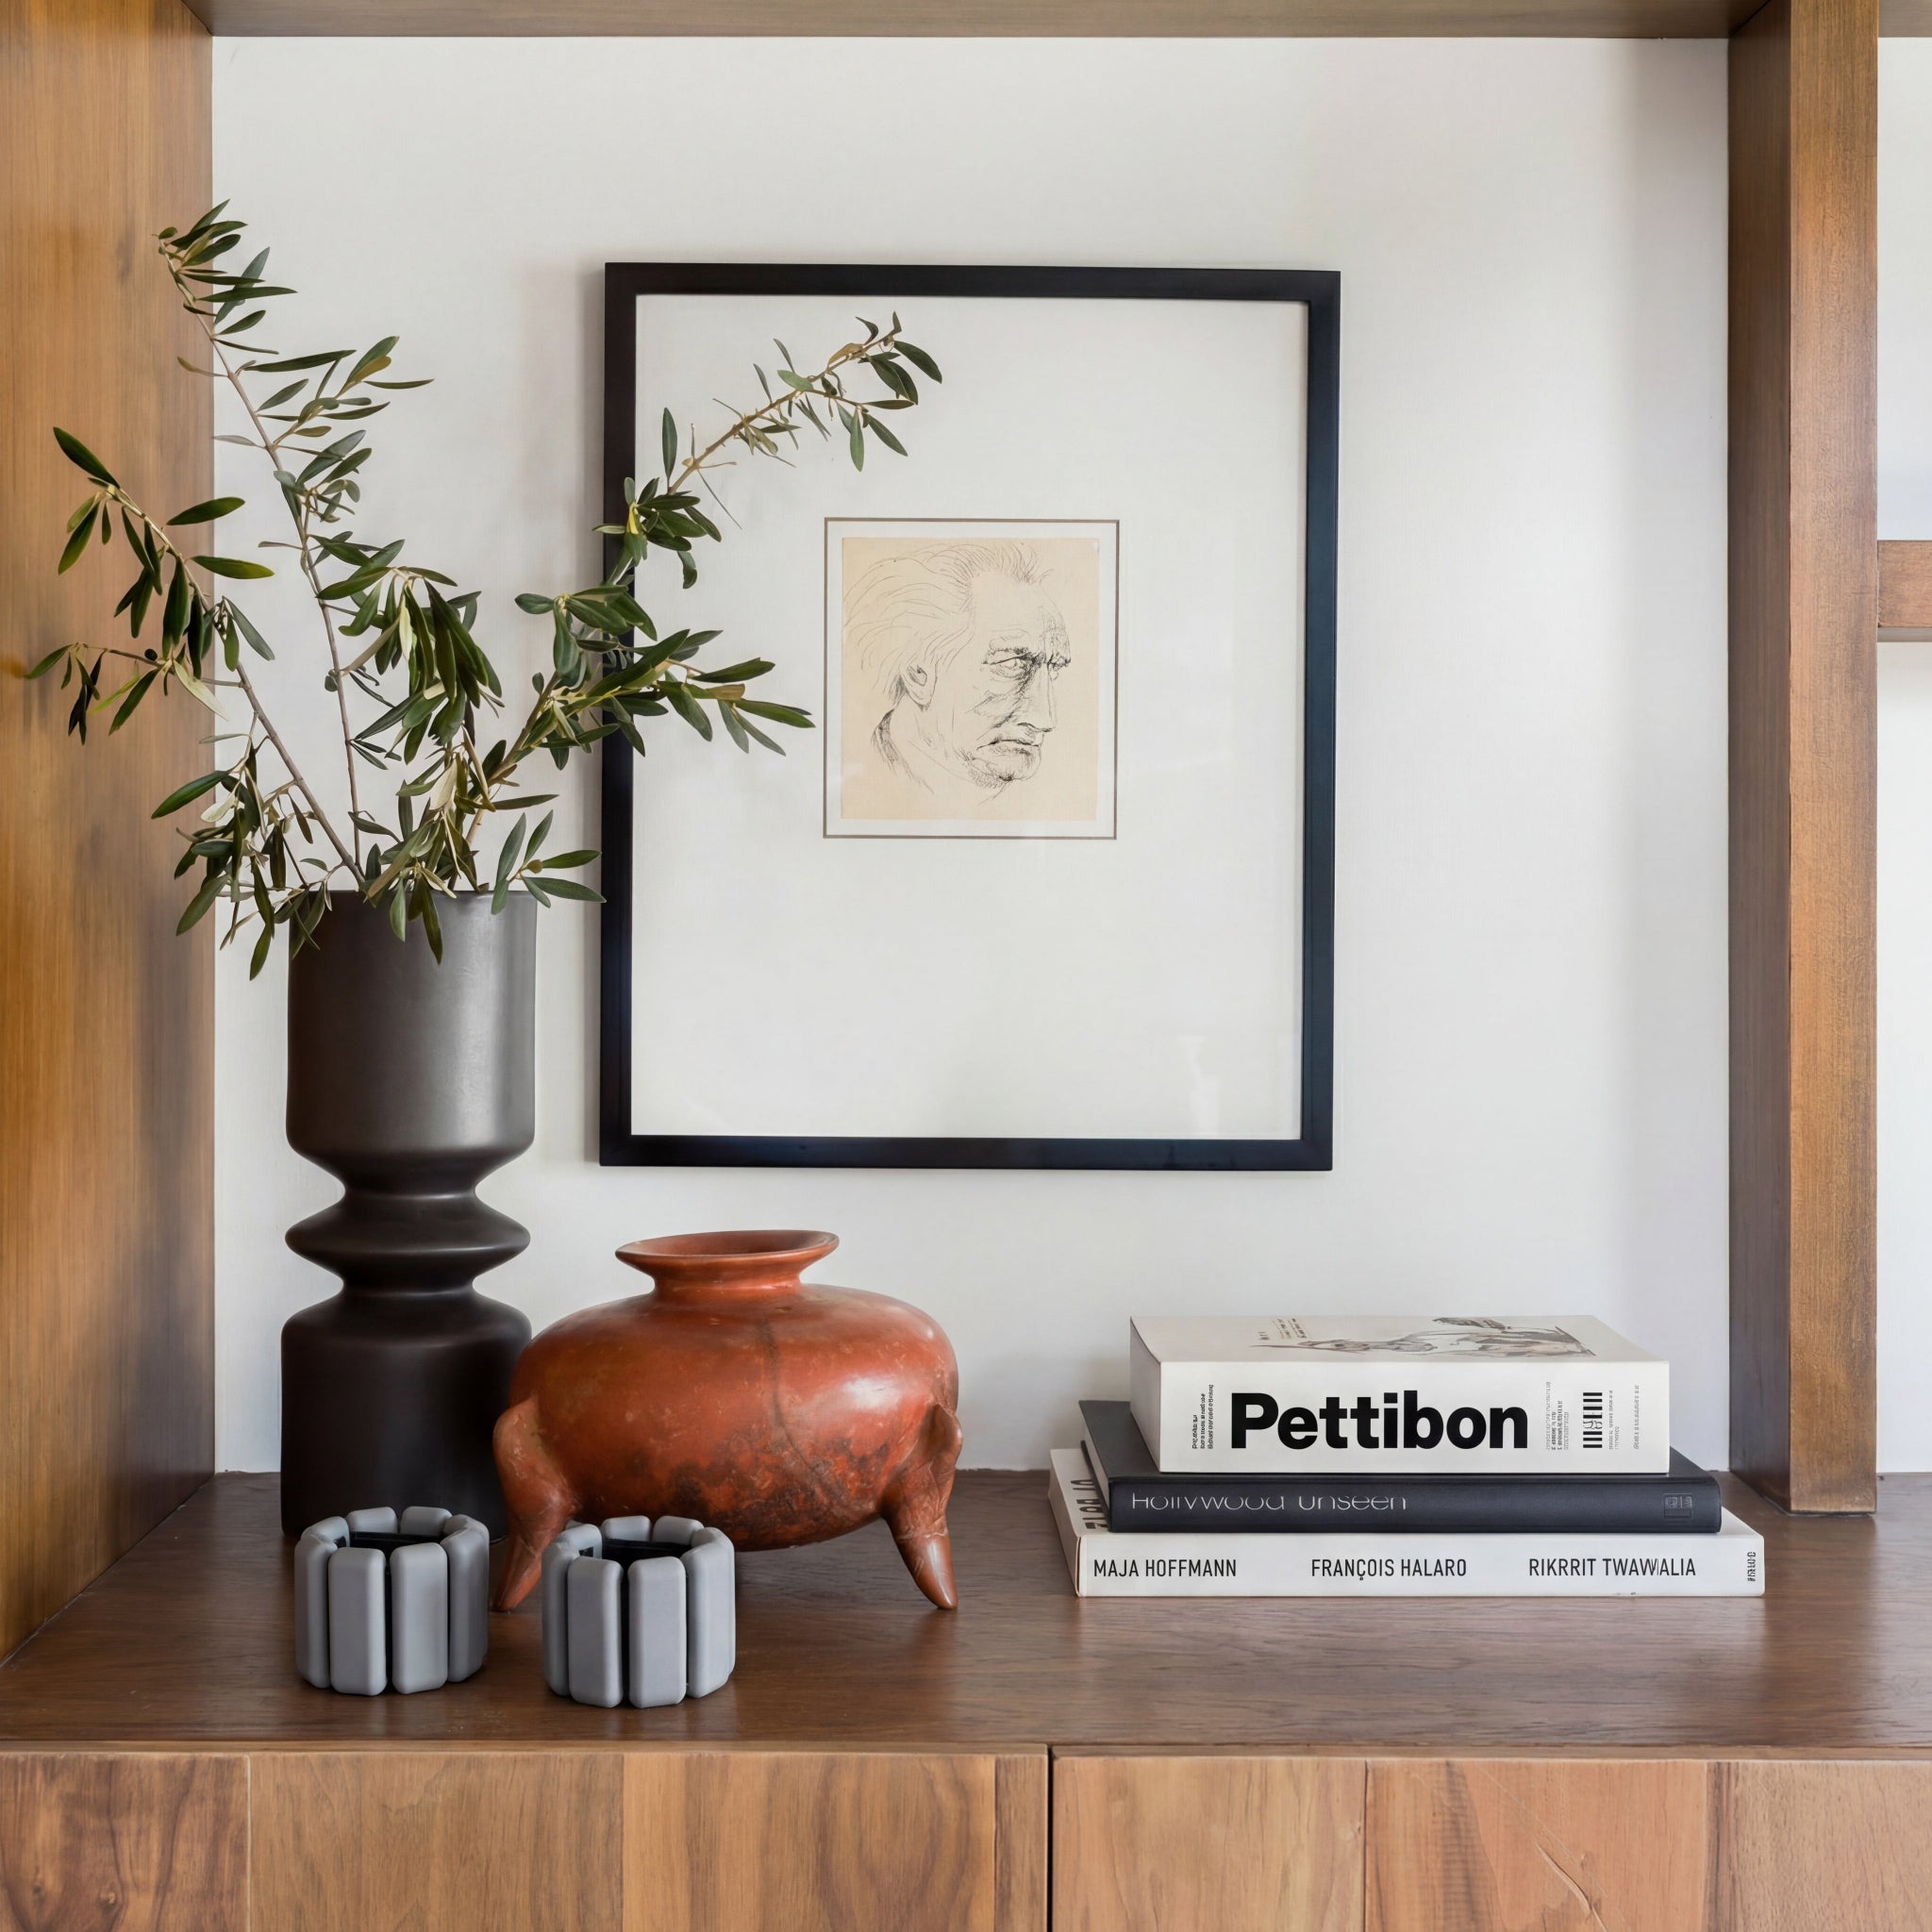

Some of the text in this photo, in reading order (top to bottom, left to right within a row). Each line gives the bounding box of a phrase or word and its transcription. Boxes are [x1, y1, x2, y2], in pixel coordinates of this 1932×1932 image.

[1231, 1390, 1528, 1450] Pettibon
[1093, 1558, 1237, 1577] MAJA HOFFMANN
[1311, 1558, 1467, 1581] FRANÇOIS HALARO
[1529, 1557, 1597, 1576] RIKRRIT
